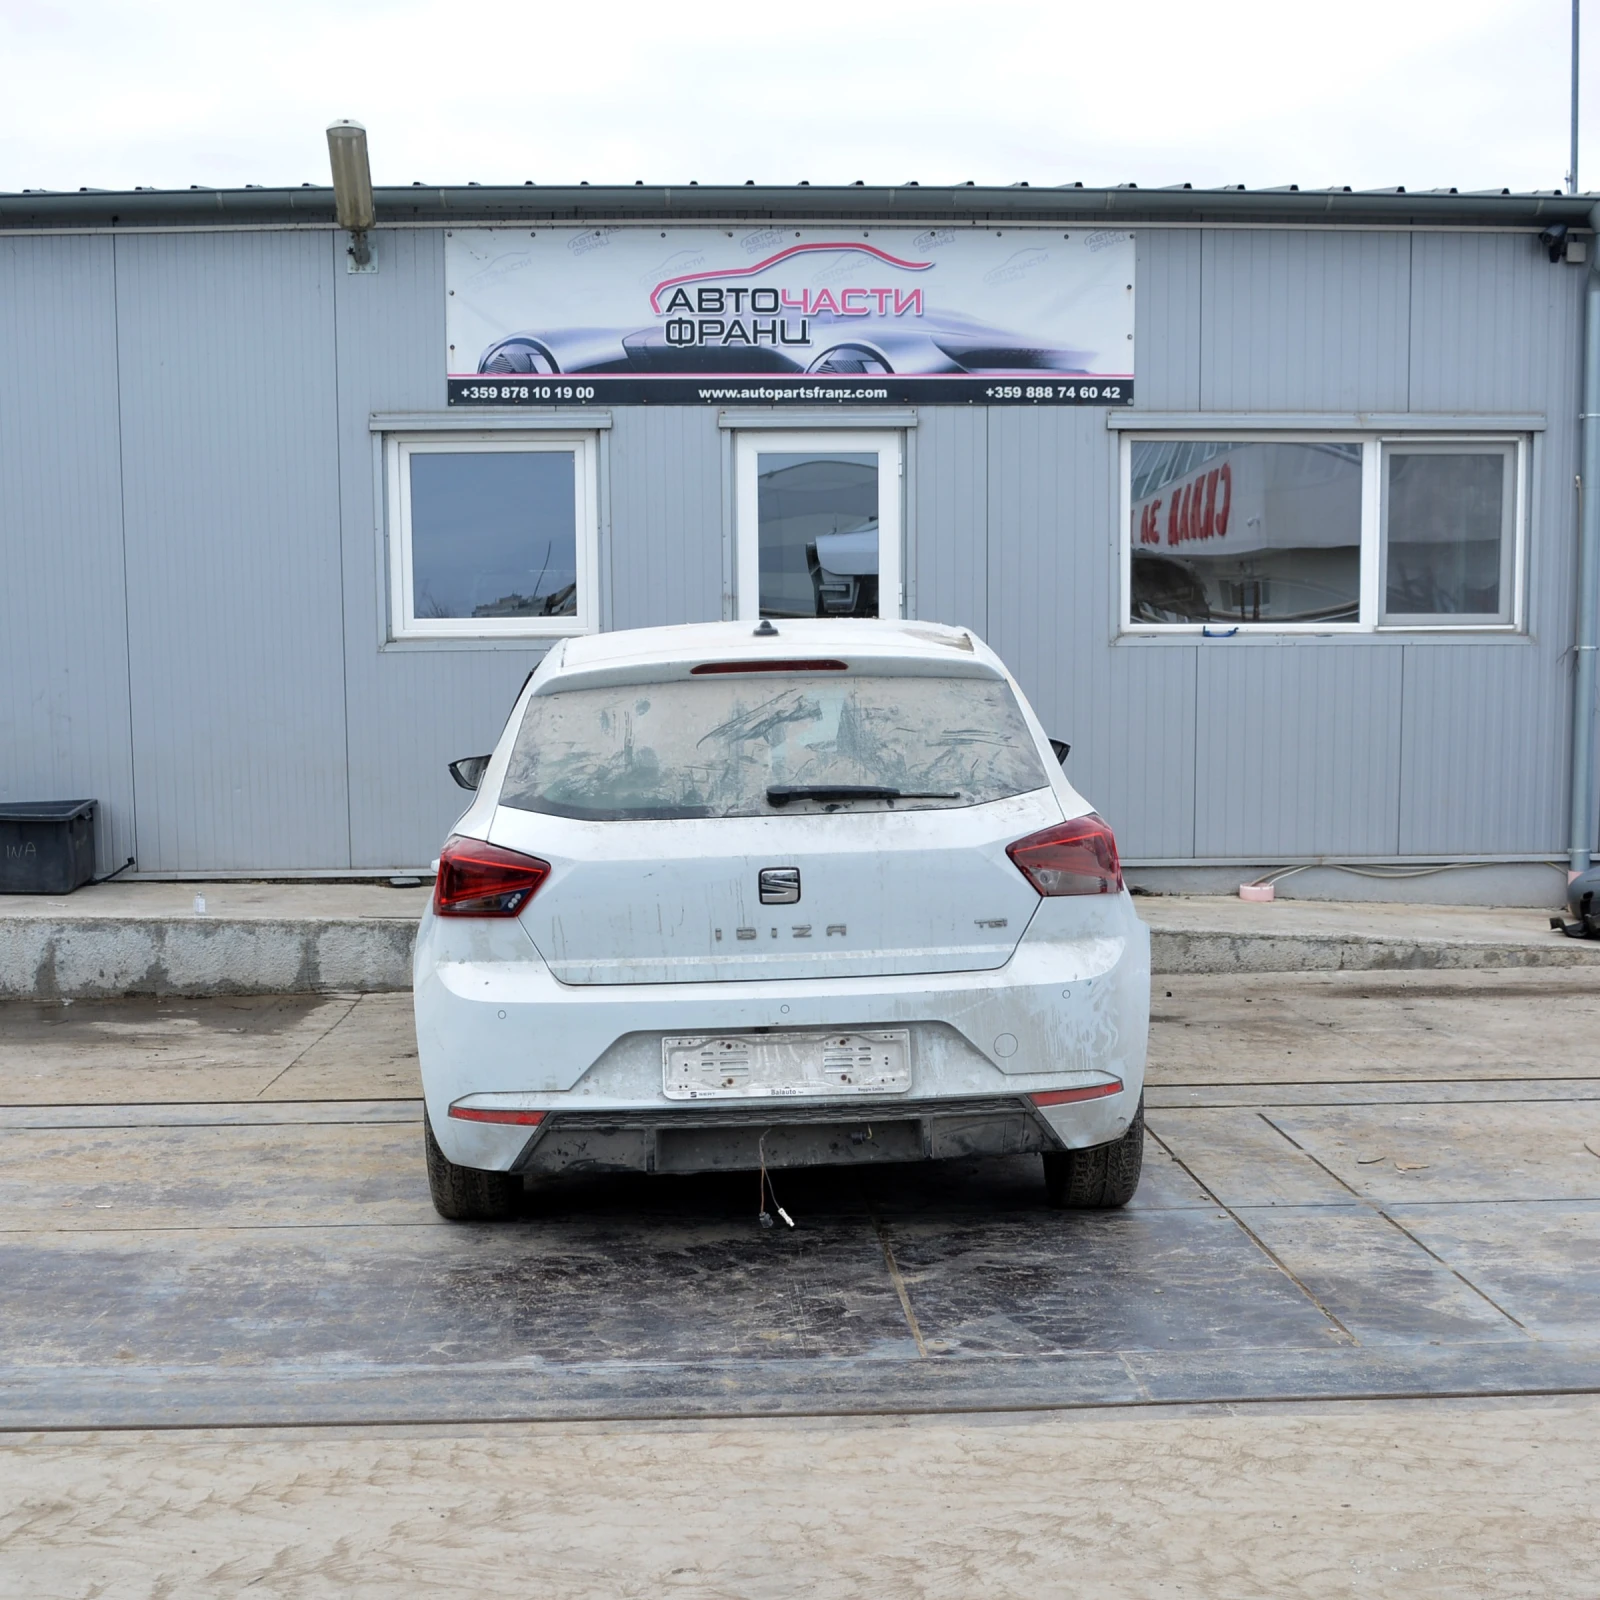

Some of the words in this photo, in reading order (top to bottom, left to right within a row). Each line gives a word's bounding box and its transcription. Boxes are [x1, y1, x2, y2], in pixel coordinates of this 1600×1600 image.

[666, 287, 922, 314] АВТОЧАСТИ
[665, 317, 810, 346] ФРАНЦ
[461, 387, 498, 399] +359
[501, 387, 528, 399] 878
[532, 387, 550, 399] 10
[554, 387, 573, 399] 19
[575, 387, 595, 399] 00
[698, 387, 888, 400] www.autopartsfranz.com
[985, 386, 1022, 399] +359
[1025, 386, 1053, 399] 888
[1057, 386, 1076, 399] 74
[1079, 386, 1098, 399] 60
[1101, 386, 1121, 399] 42
[714, 922, 847, 942] IBIZA
